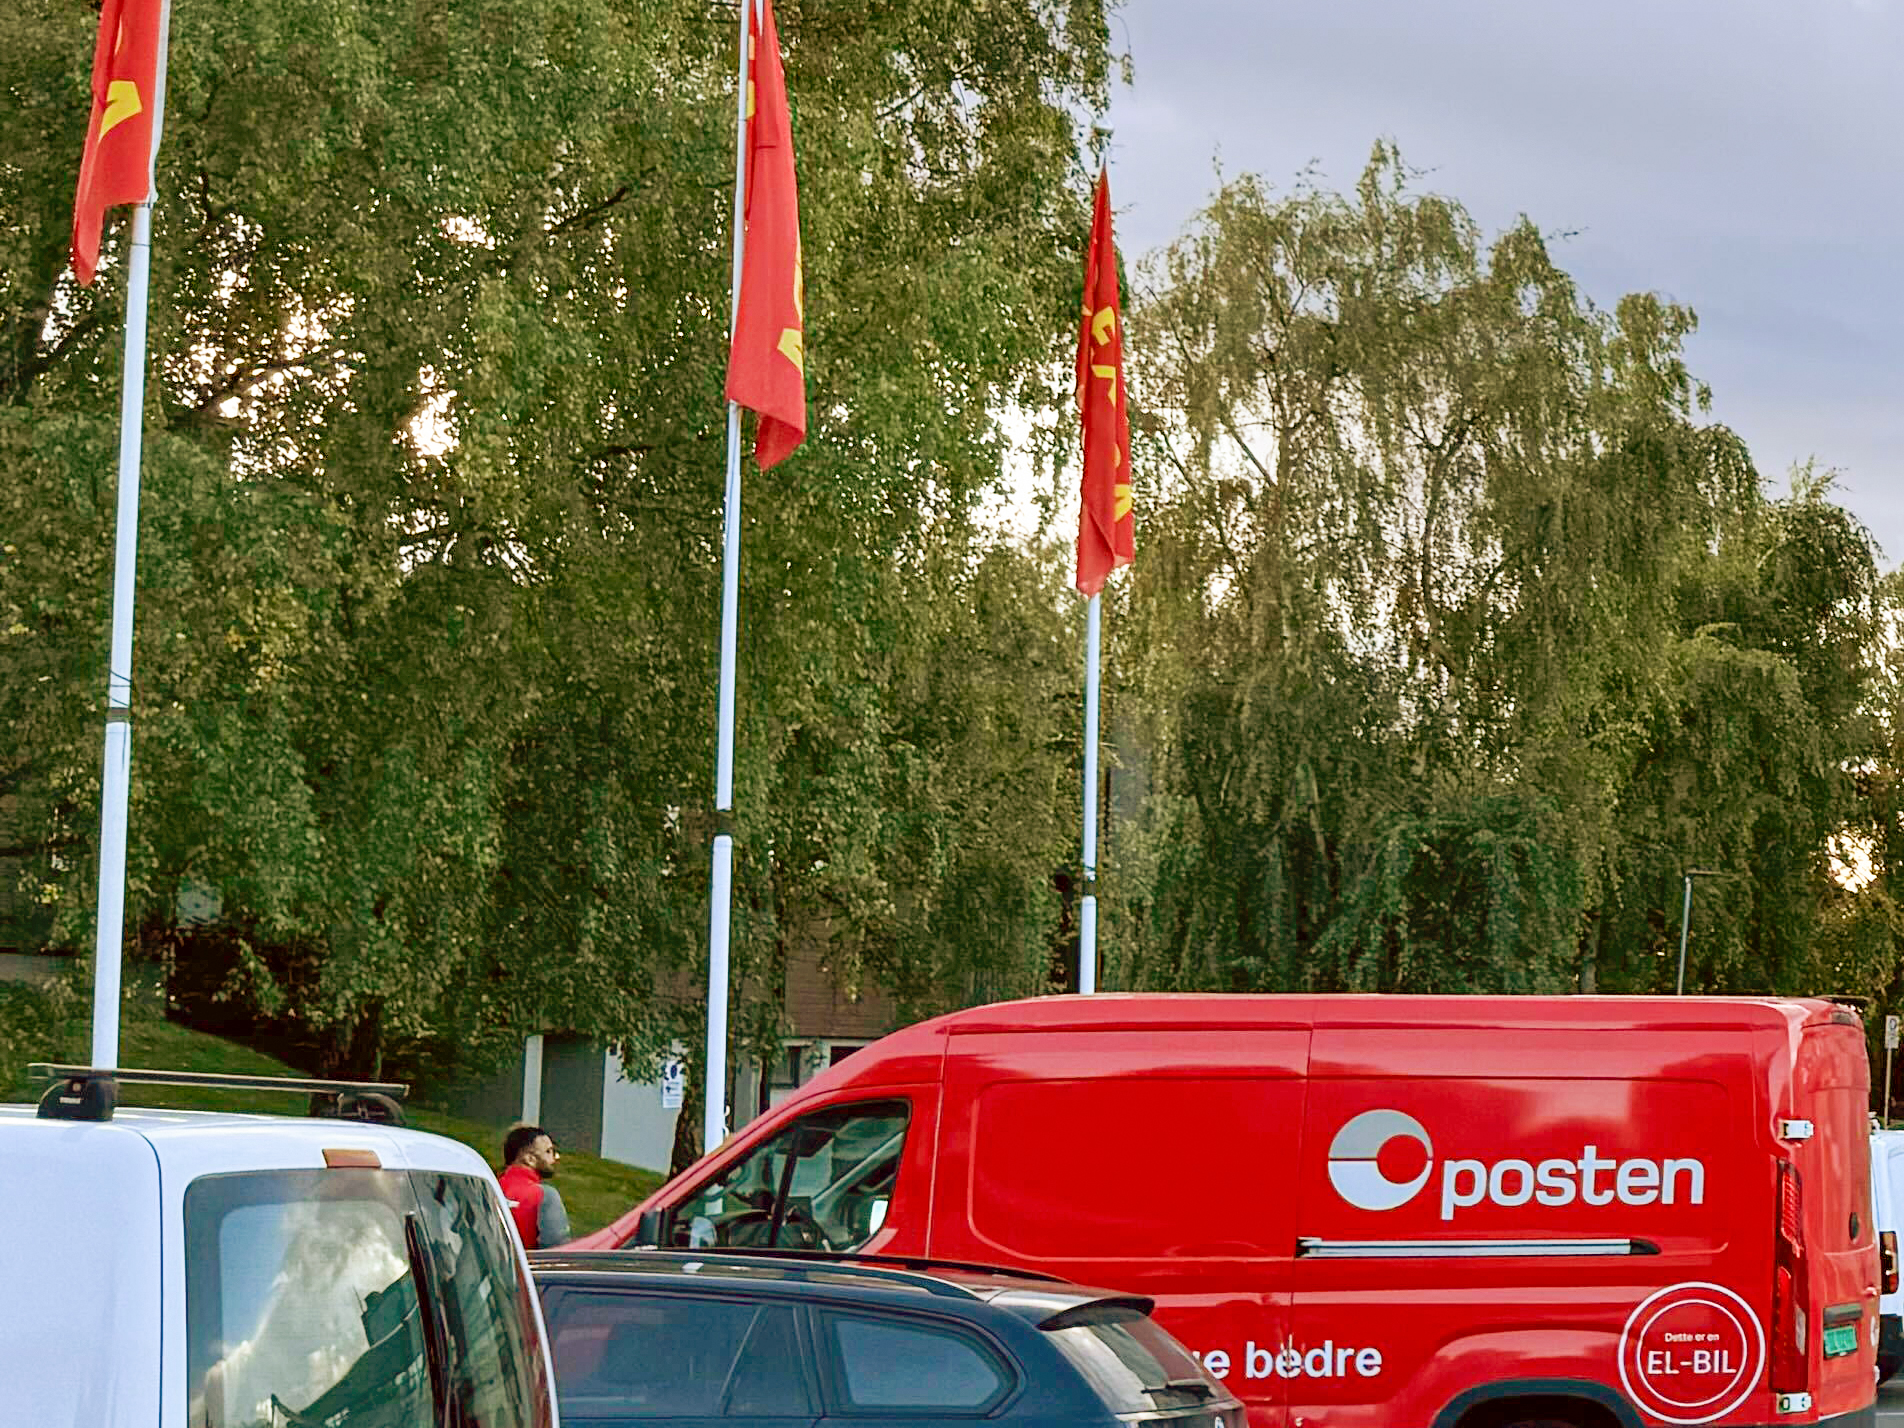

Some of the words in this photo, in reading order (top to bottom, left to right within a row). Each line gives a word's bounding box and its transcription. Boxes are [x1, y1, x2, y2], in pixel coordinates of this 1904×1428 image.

[1440, 1145, 1705, 1221] posten
[1664, 1332, 1693, 1342] Dette
[1694, 1333, 1706, 1342] er
[1706, 1333, 1720, 1342] en
[1245, 1340, 1383, 1379] bedre
[1647, 1350, 1737, 1375] EL-BIL
